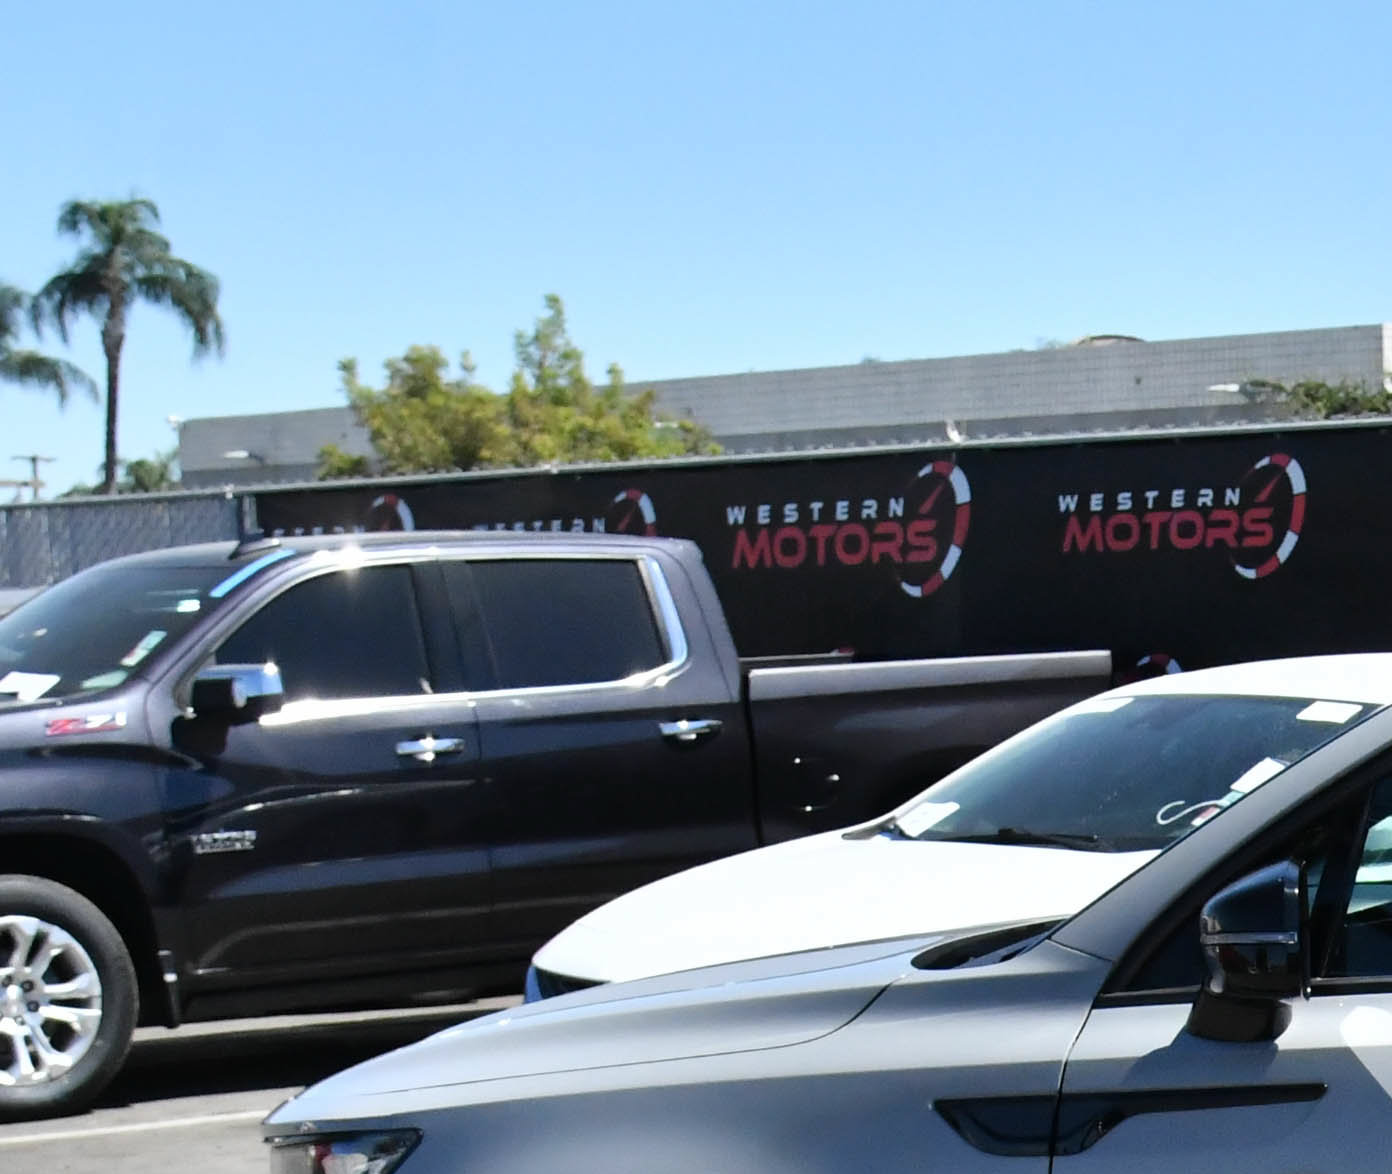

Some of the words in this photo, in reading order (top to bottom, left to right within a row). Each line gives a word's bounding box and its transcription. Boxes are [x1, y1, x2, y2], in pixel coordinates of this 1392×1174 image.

[726, 497, 905, 526] WESTERN
[1058, 487, 1241, 513] WESTERN
[732, 519, 938, 569] MOTORS
[1062, 507, 1275, 553] MOTORS
